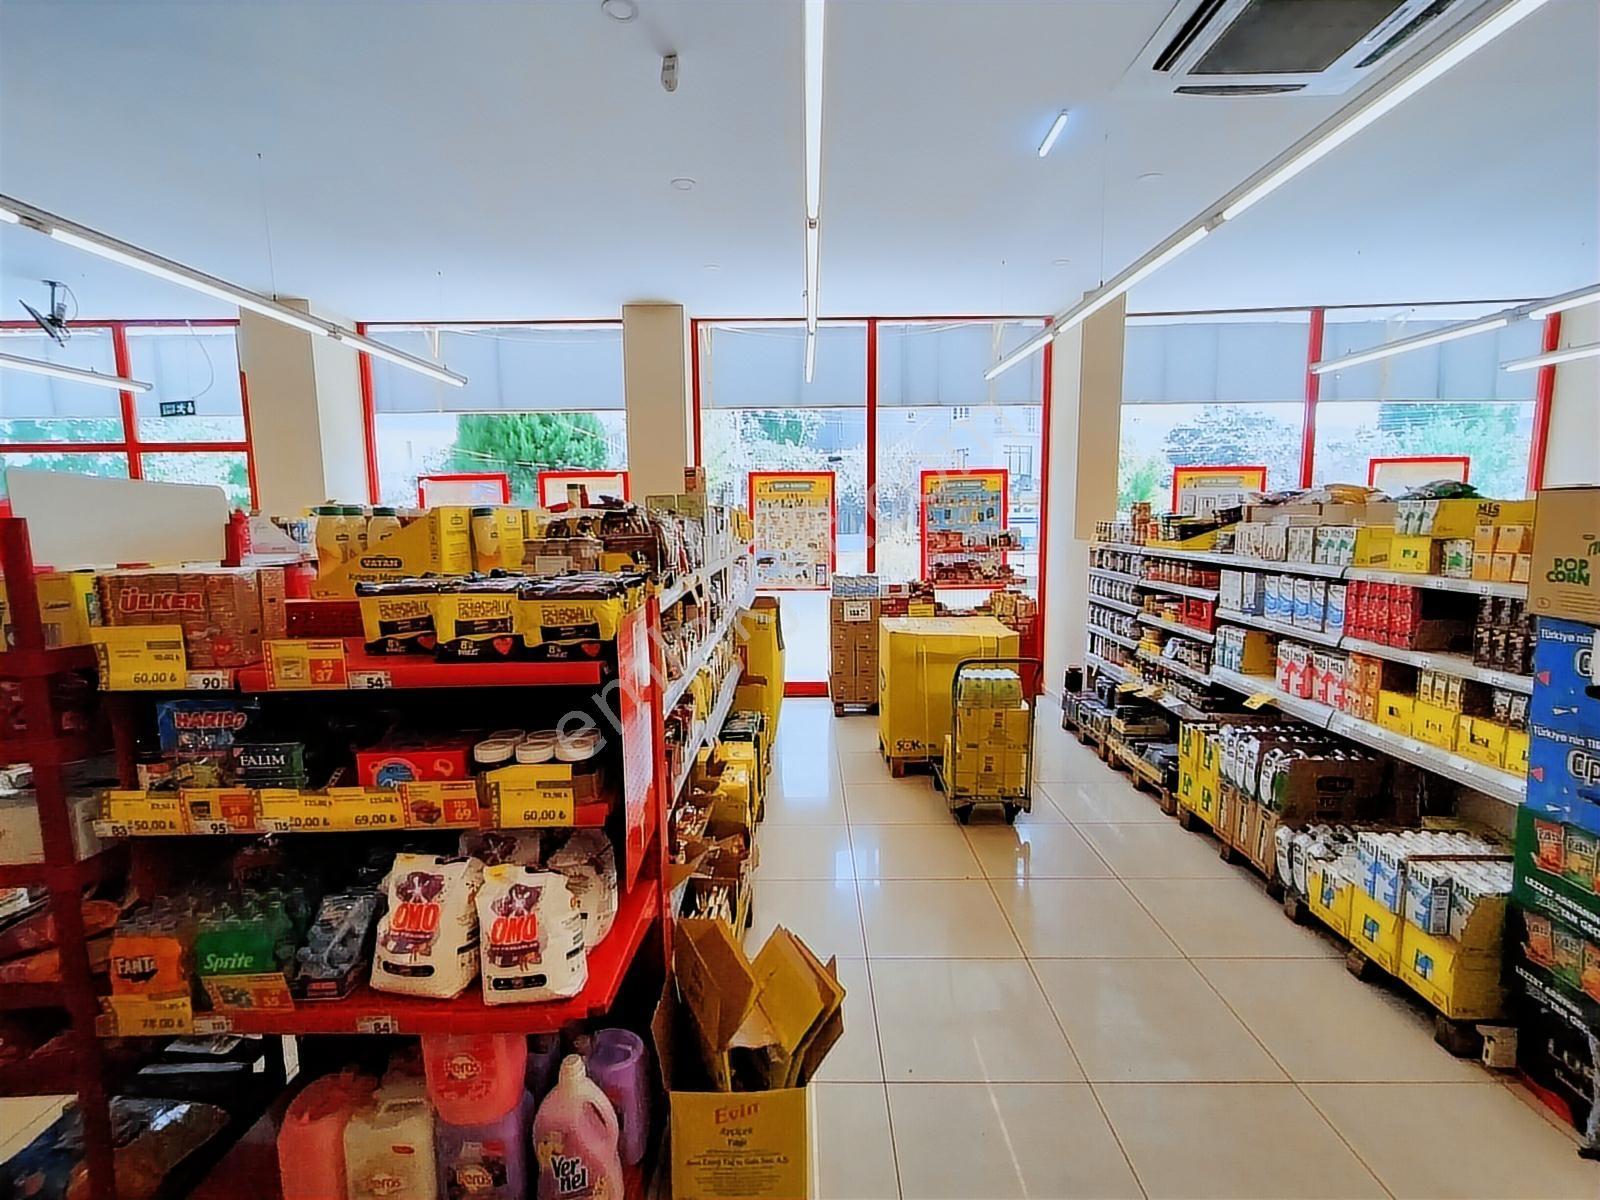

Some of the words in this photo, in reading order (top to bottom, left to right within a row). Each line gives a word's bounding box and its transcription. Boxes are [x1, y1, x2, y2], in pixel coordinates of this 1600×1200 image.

[1553, 557, 1589, 574] POP
[1546, 570, 1591, 587] CORN
[119, 586, 205, 613] ÜLKER
[315, 669, 334, 682] 37
[202, 677, 220, 690] 90
[366, 677, 385, 690] 54
[174, 710, 248, 731] HARIBO
[240, 754, 285, 767] FALIM
[290, 817, 320, 828] 0,00
[354, 814, 387, 825] 69,00
[455, 809, 472, 821] 69
[523, 810, 556, 821] 60,00
[210, 823, 227, 834] 95
[391, 901, 442, 933] OMO
[489, 912, 539, 947] OMO
[203, 953, 254, 973] Sprite
[373, 1022, 390, 1034] 84
[714, 1102, 760, 1124] Evin
[550, 1154, 580, 1178] Ver
[558, 1167, 588, 1194] nel
